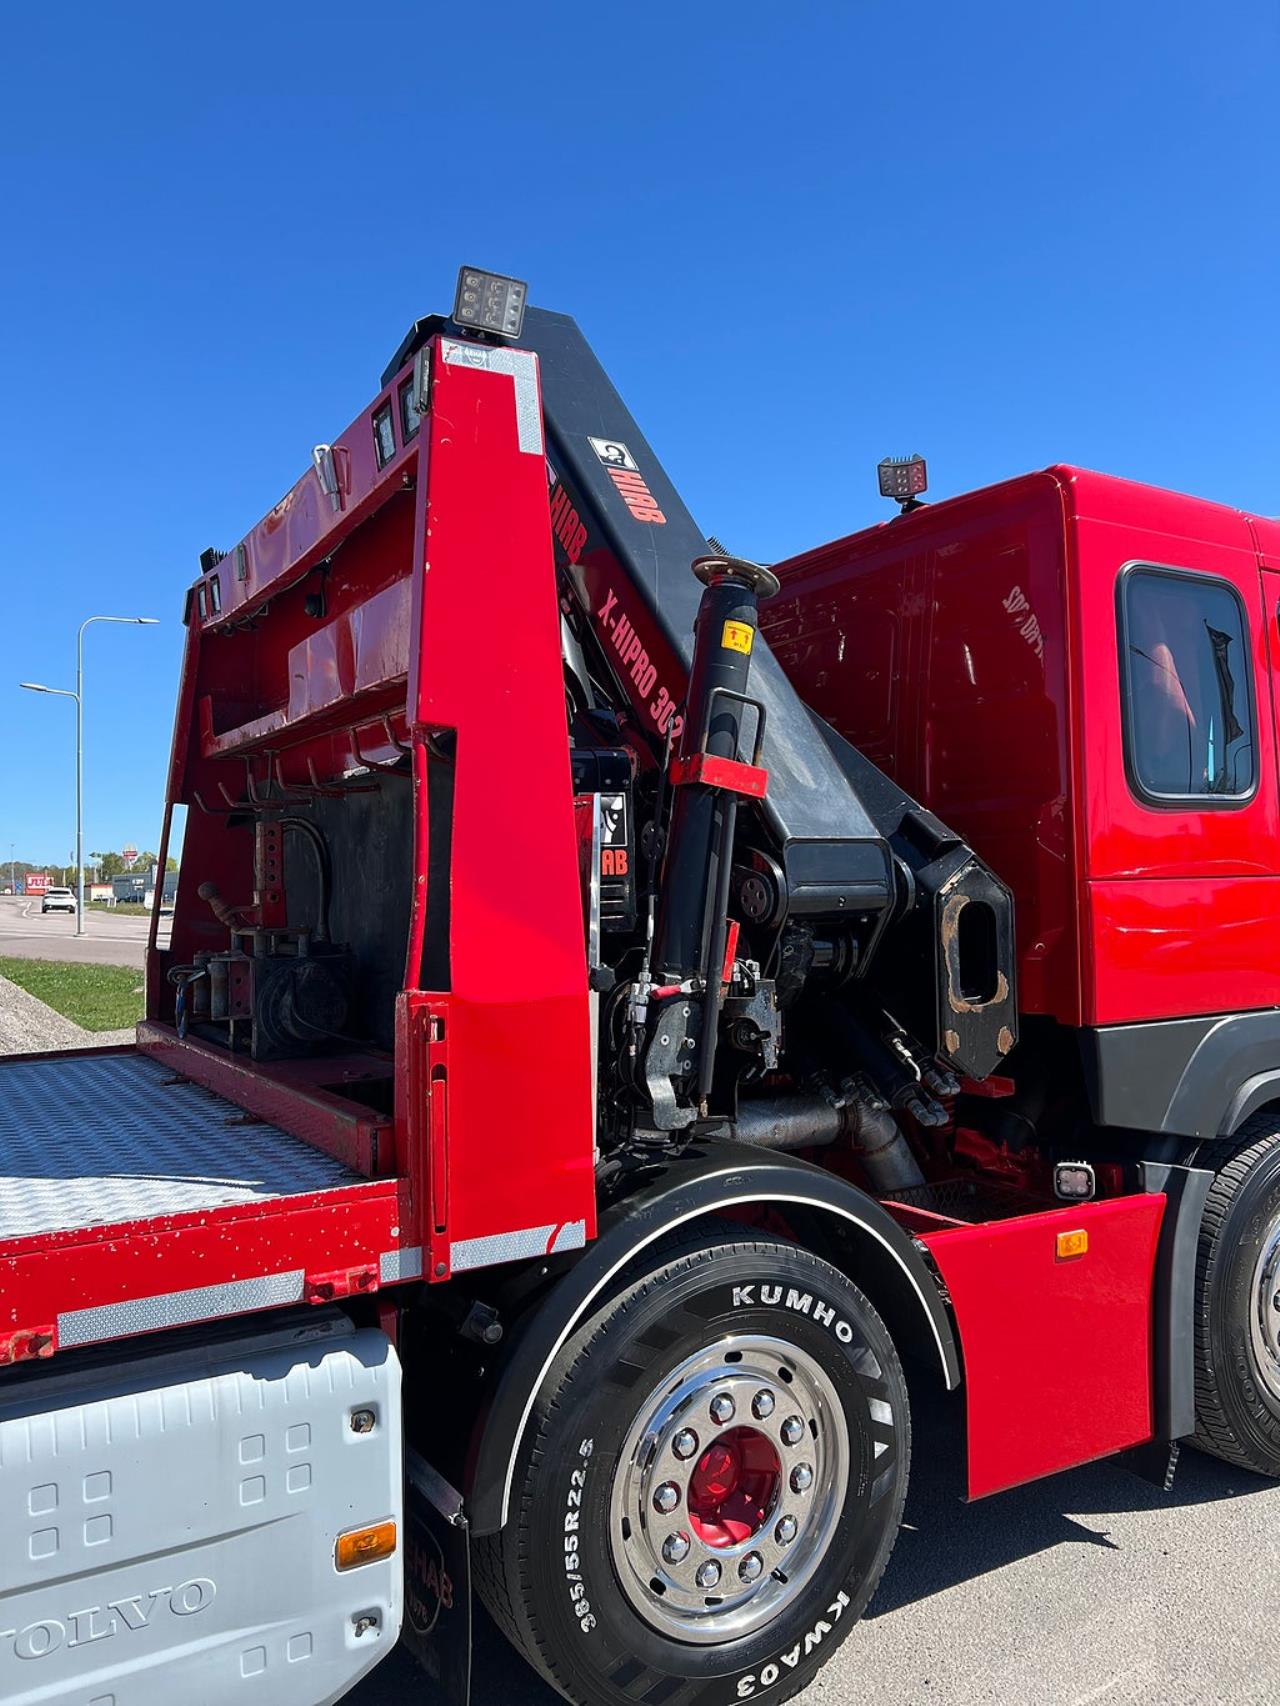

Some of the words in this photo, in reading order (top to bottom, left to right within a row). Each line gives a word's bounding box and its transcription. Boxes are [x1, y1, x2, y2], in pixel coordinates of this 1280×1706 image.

[549, 484, 588, 564] HIAB
[607, 467, 667, 524] HIAB
[598, 588, 658, 698] X-HIPRO
[732, 1285, 853, 1343] KUMHO
[564, 1438, 597, 1633] 385/55R22.5
[0, 1577, 217, 1661] OLVO
[736, 1590, 850, 1698] KWA03
